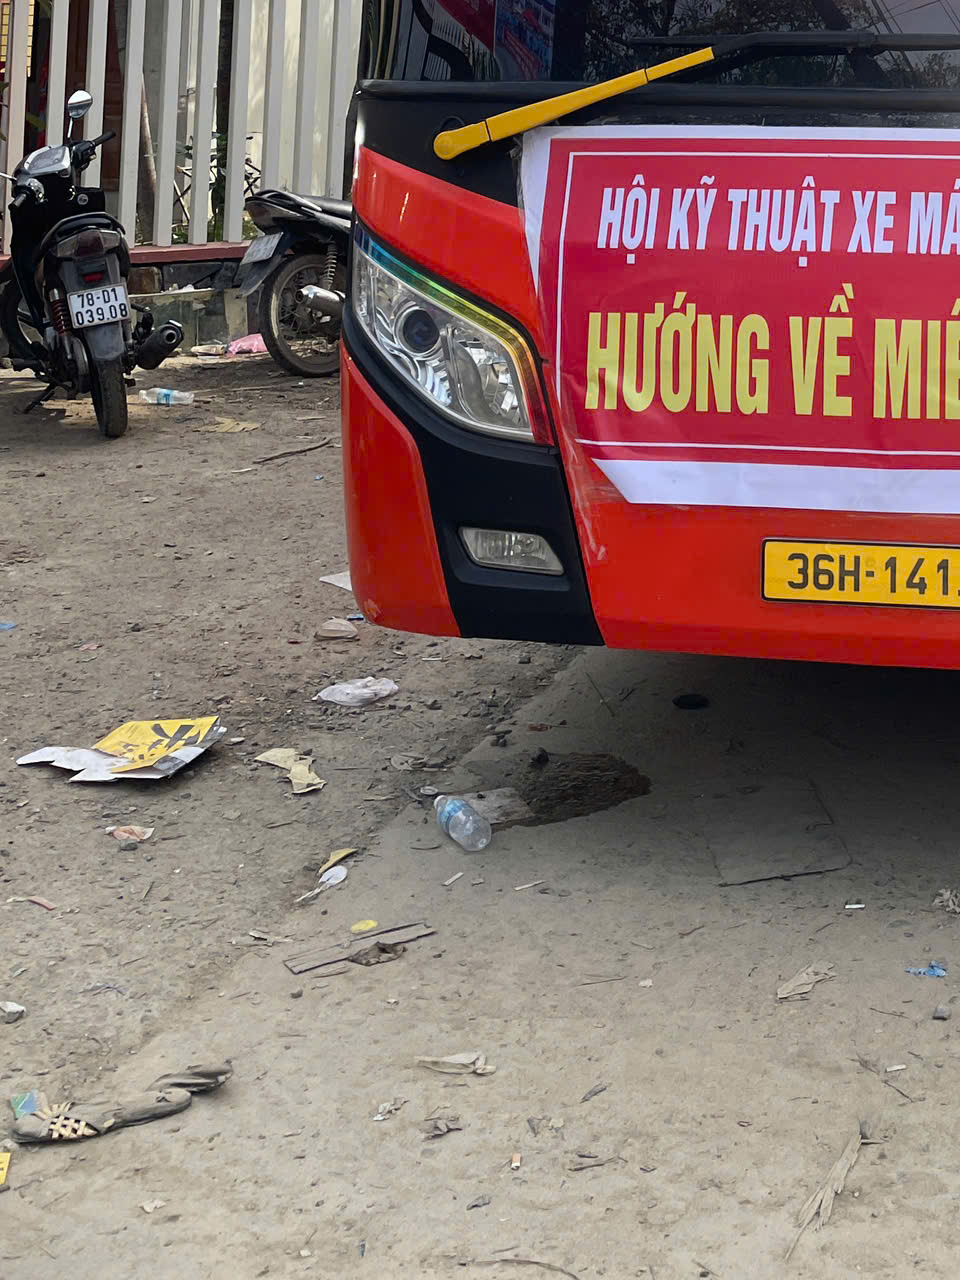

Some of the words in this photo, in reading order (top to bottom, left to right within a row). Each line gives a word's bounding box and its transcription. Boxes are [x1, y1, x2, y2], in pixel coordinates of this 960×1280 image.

[597, 174, 660, 264] HỘI
[667, 175, 718, 250] KỸ
[728, 176, 840, 267] THUẬT
[847, 191, 897, 253] XE
[76, 303, 128, 325] 039.08
[77, 287, 118, 308] 78-D1
[585, 292, 769, 415] HƯỚNG
[789, 283, 854, 417] VỀ
